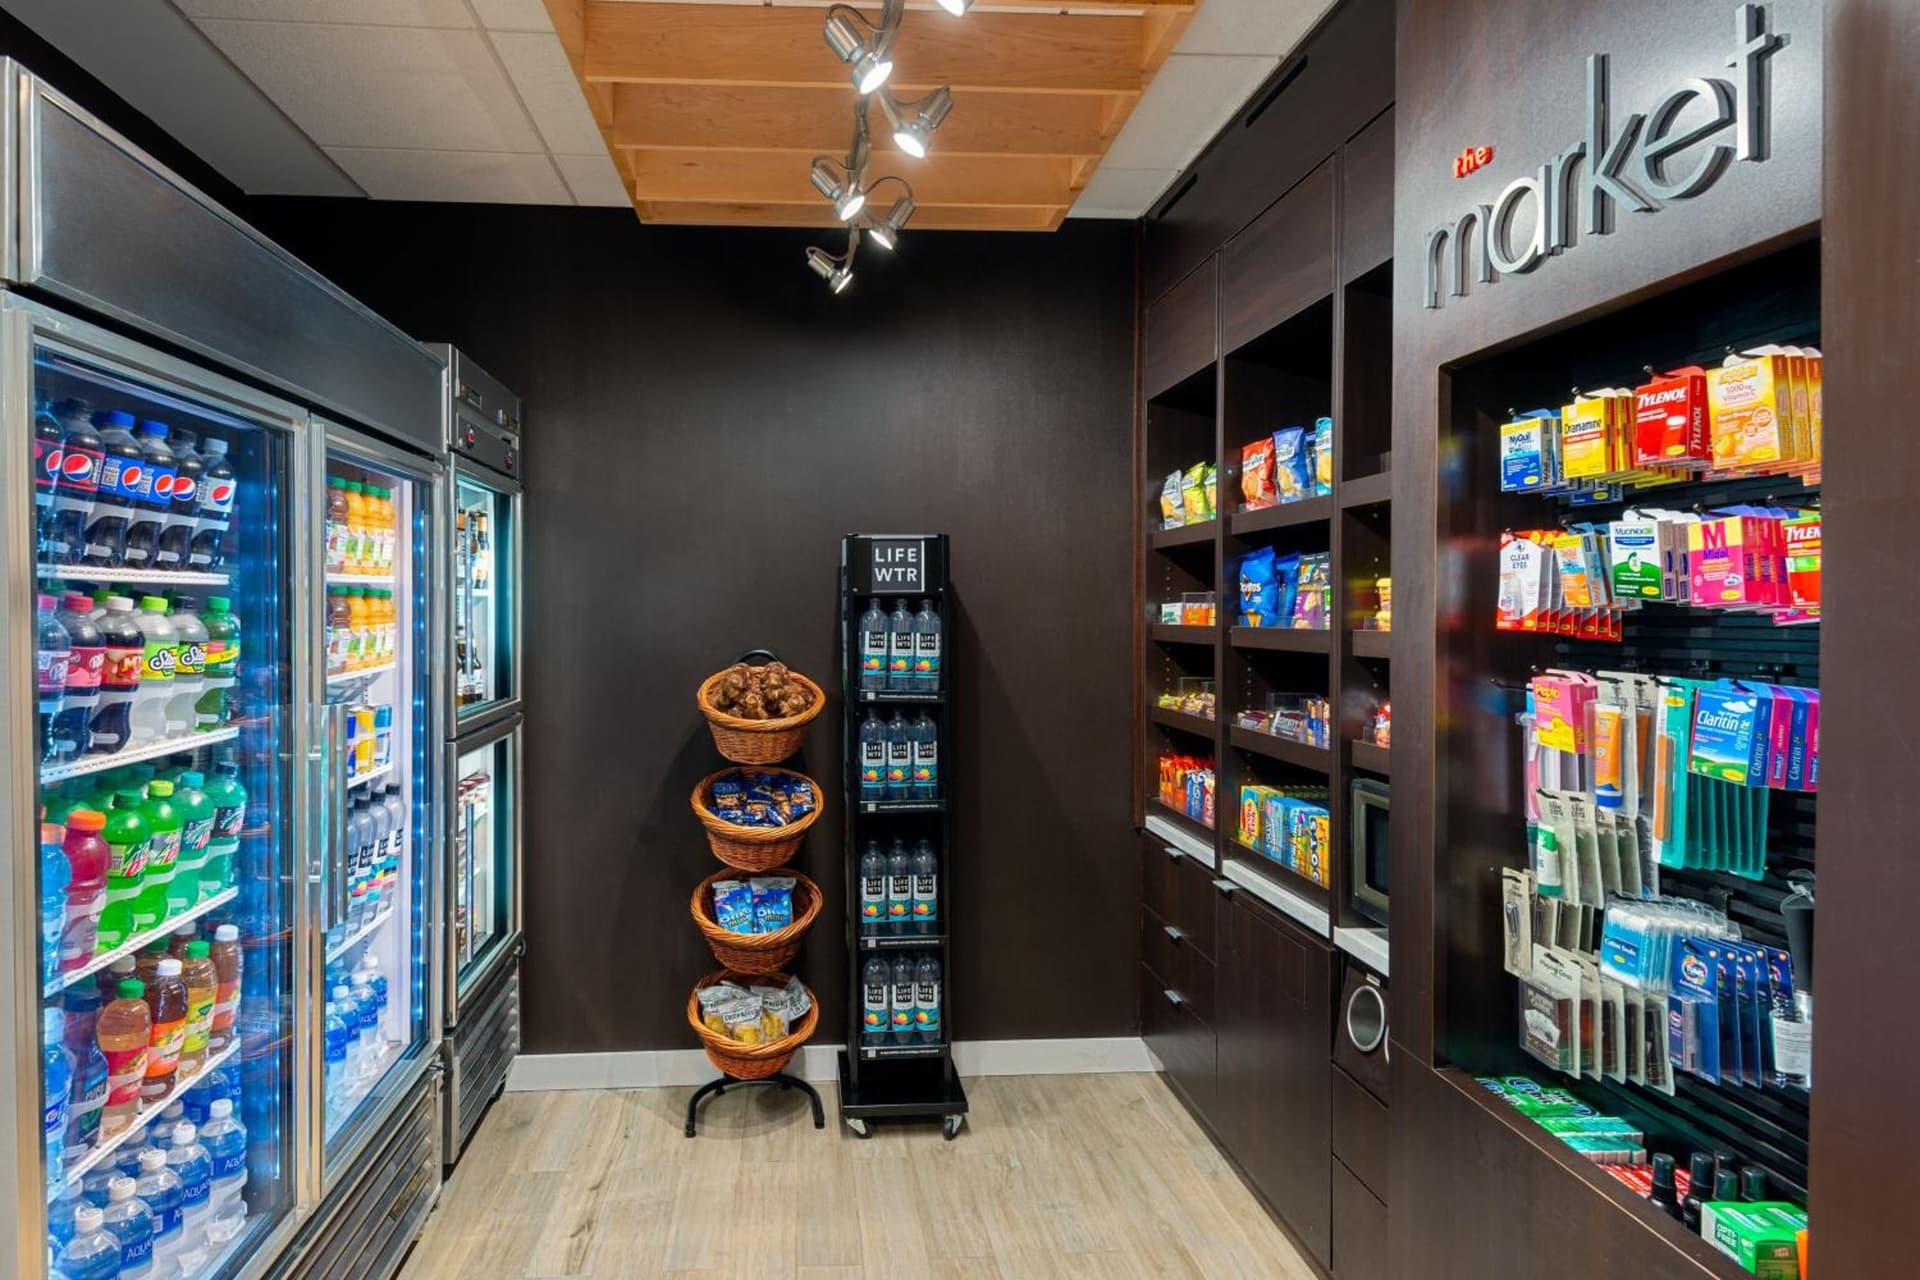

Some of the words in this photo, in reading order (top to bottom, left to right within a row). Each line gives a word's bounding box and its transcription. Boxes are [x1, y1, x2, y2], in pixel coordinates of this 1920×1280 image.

[1424, 3, 1791, 309] market
[1454, 145, 1494, 178] the
[1637, 386, 1687, 409] TYLENOL
[875, 548, 917, 562] LIFE
[1510, 554, 1529, 562] CLEAR
[875, 568, 917, 582] WTR
[1697, 710, 1739, 731] Claritin
[1750, 743, 1765, 777] Claritin
[1788, 746, 1802, 780] Claritin
